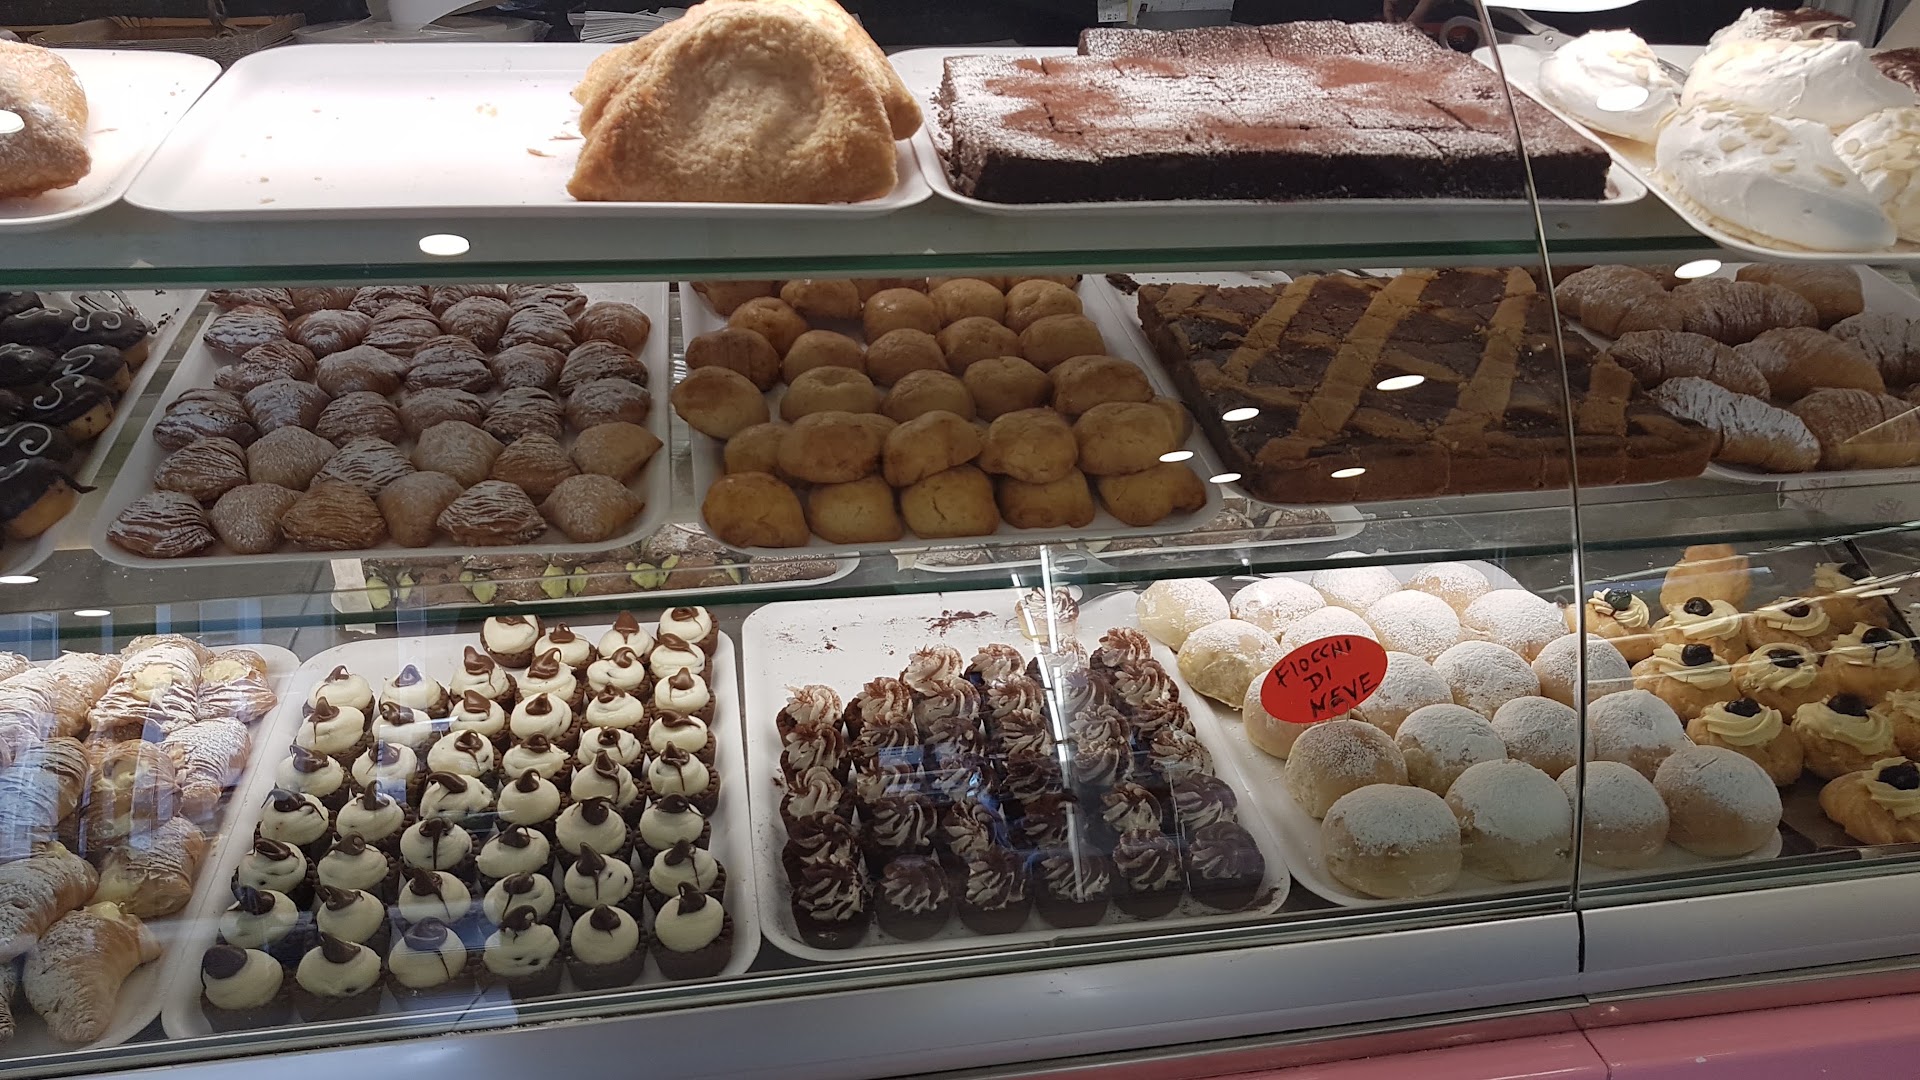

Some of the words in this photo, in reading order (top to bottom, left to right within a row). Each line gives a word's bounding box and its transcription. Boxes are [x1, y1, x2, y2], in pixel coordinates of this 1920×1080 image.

[1275, 638, 1352, 688] FIOCCHI
[1303, 665, 1332, 693] DI
[1310, 672, 1378, 718] NEVE
